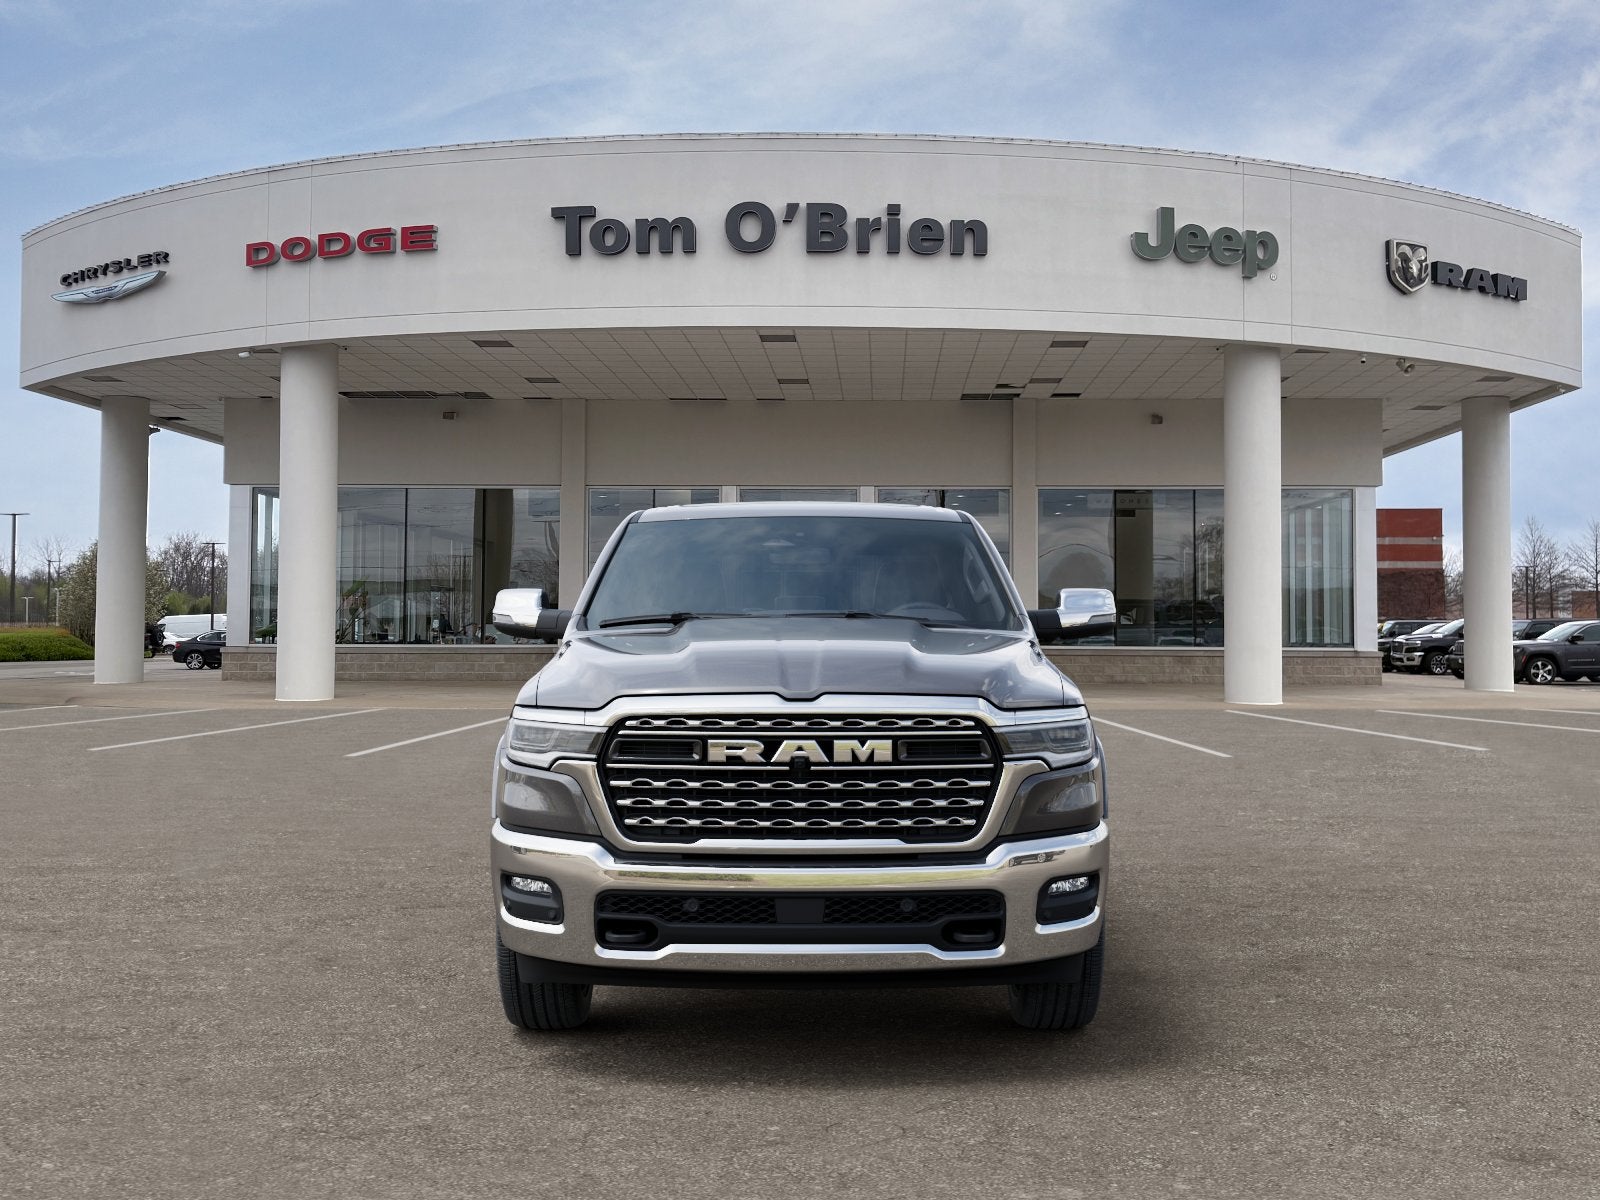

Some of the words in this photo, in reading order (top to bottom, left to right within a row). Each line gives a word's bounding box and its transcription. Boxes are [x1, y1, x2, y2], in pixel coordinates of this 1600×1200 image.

[245, 224, 438, 268] DODGE
[551, 205, 697, 256] Tom
[725, 201, 988, 257] O'Brien
[1130, 206, 1279, 279] Jeep
[60, 250, 169, 286] CHRYSLER
[1431, 261, 1527, 301] RAM
[707, 739, 893, 763] RAM
